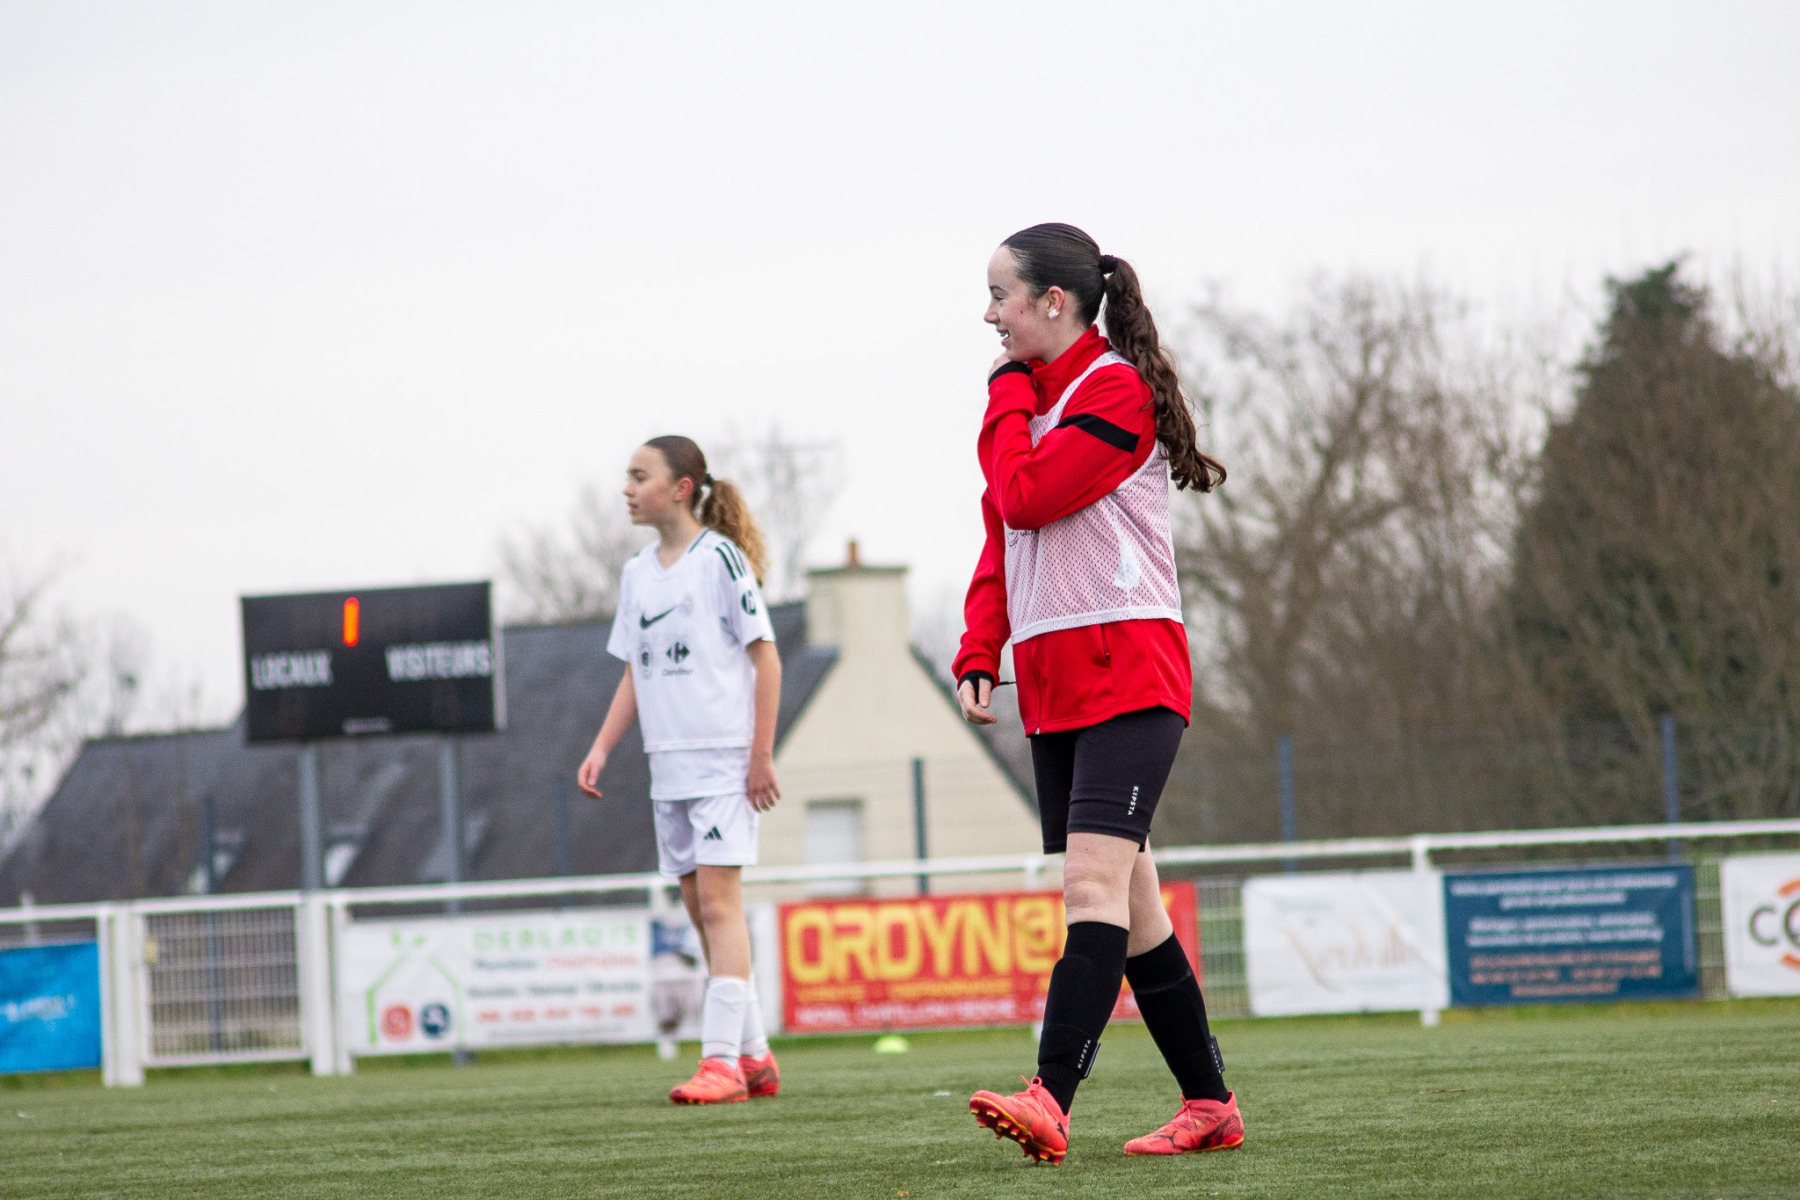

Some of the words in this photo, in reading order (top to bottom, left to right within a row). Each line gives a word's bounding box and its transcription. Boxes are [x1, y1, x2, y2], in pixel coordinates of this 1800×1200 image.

[252, 652, 331, 689] LOCAUX
[386, 640, 491, 682] VISITEURS
[1127, 786, 1139, 815] KIPSTA
